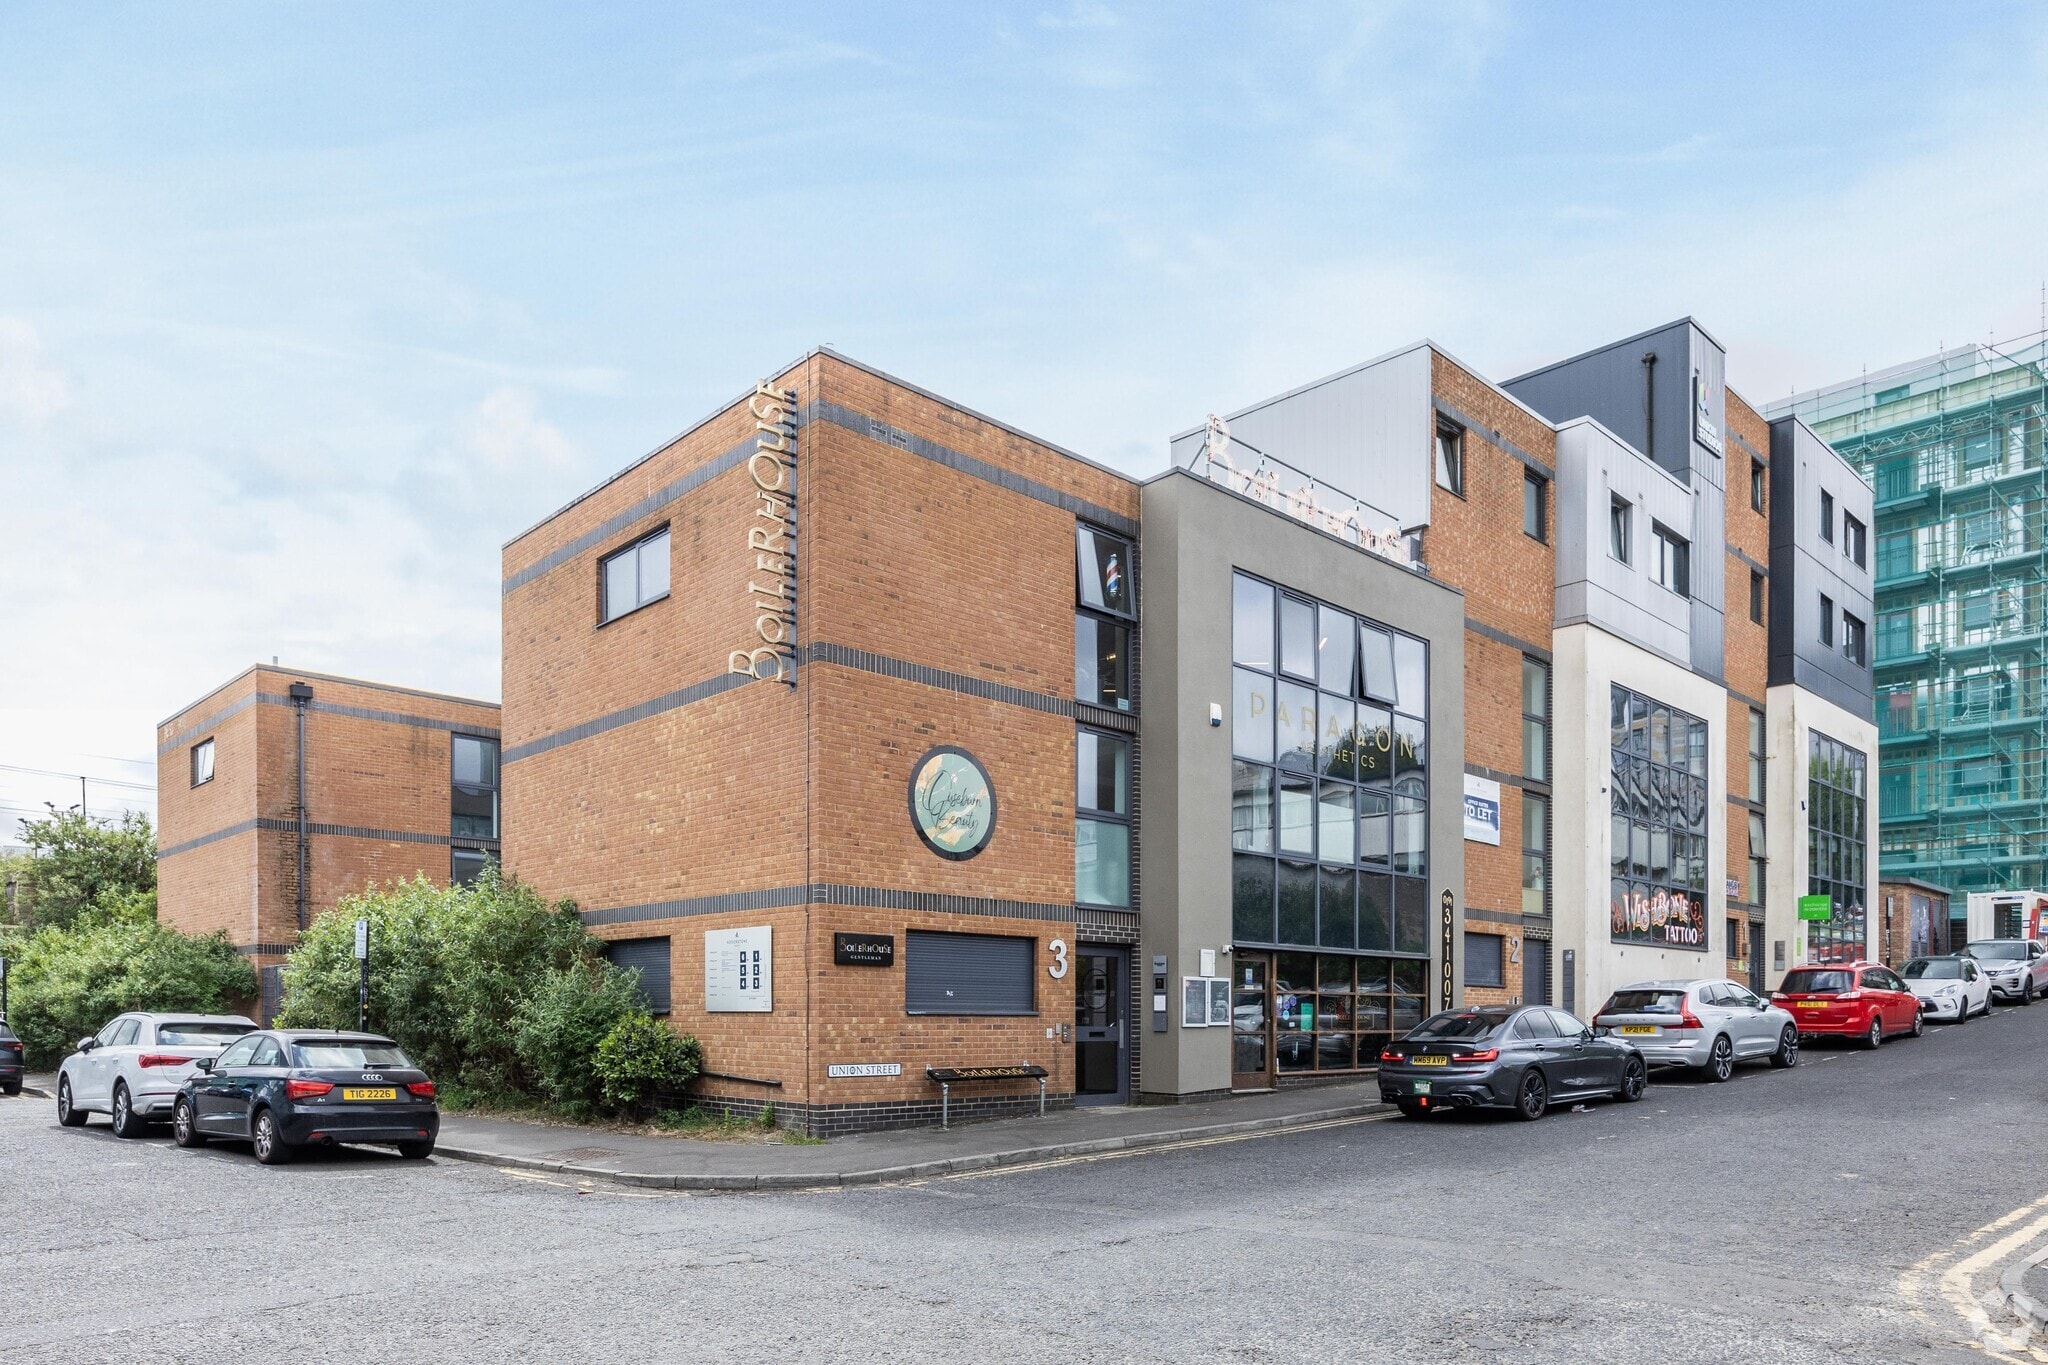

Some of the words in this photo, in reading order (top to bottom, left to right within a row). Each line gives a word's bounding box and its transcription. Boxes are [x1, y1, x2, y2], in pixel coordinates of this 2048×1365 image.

[729, 378, 785, 682] BOILERHOUSE
[1250, 692, 1414, 759] PARAGON
[1464, 804, 1475, 817] TO
[1477, 807, 1493, 821] LET
[1664, 925, 1698, 944] TATTOO
[840, 937, 891, 954] BOILERHOUSE
[1510, 936, 1521, 963] 2
[1048, 939, 1068, 979] 3
[1432, 1056, 1446, 1064] AVP
[831, 1066, 863, 1076] UNION
[866, 1065, 898, 1075] STREET
[350, 1090, 365, 1098] TIG
[367, 1089, 391, 1098] 2226
